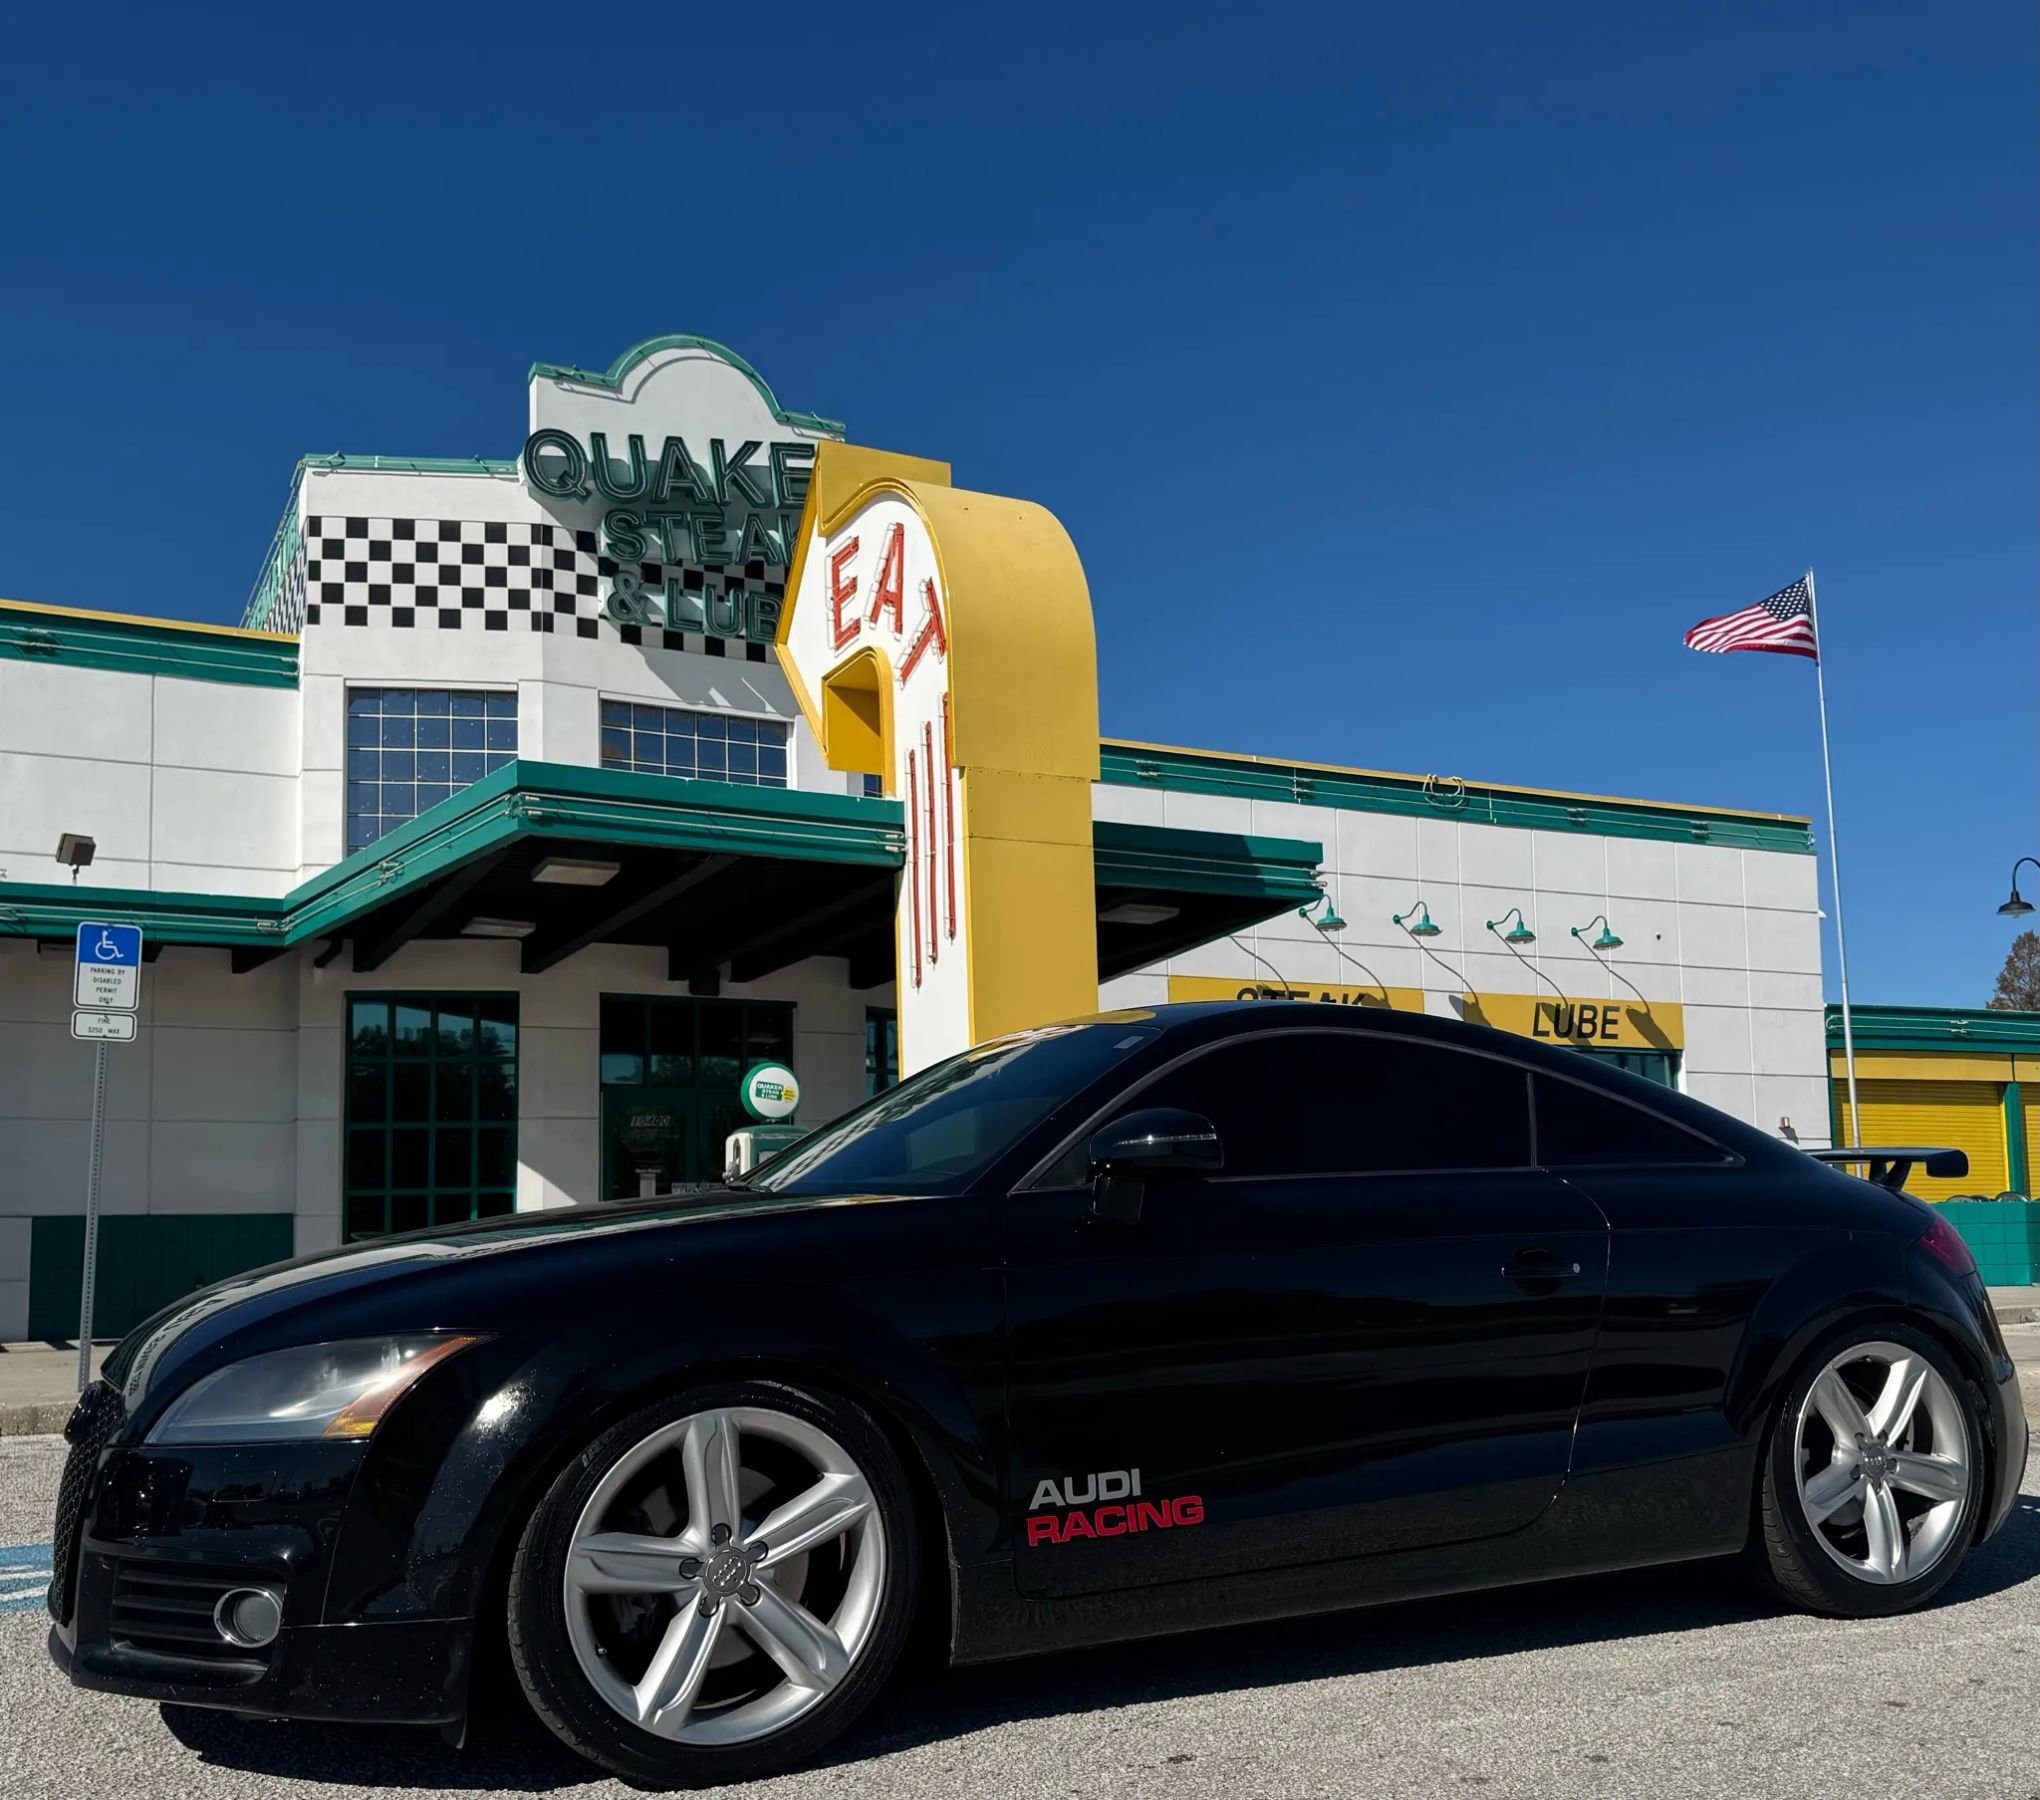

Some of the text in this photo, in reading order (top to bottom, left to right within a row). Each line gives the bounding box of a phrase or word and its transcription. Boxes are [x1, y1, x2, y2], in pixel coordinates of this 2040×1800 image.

[606, 569, 652, 626] &
[829, 521, 948, 685] EAT
[93, 977, 122, 985] DISABLED
[98, 996, 113, 1004] ONLY
[1533, 1002, 1621, 1041] LUBE
[757, 1083, 783, 1091] QUAKER
[1028, 1468, 1142, 1511] AUDI
[1026, 1495, 1205, 1547] RACING
